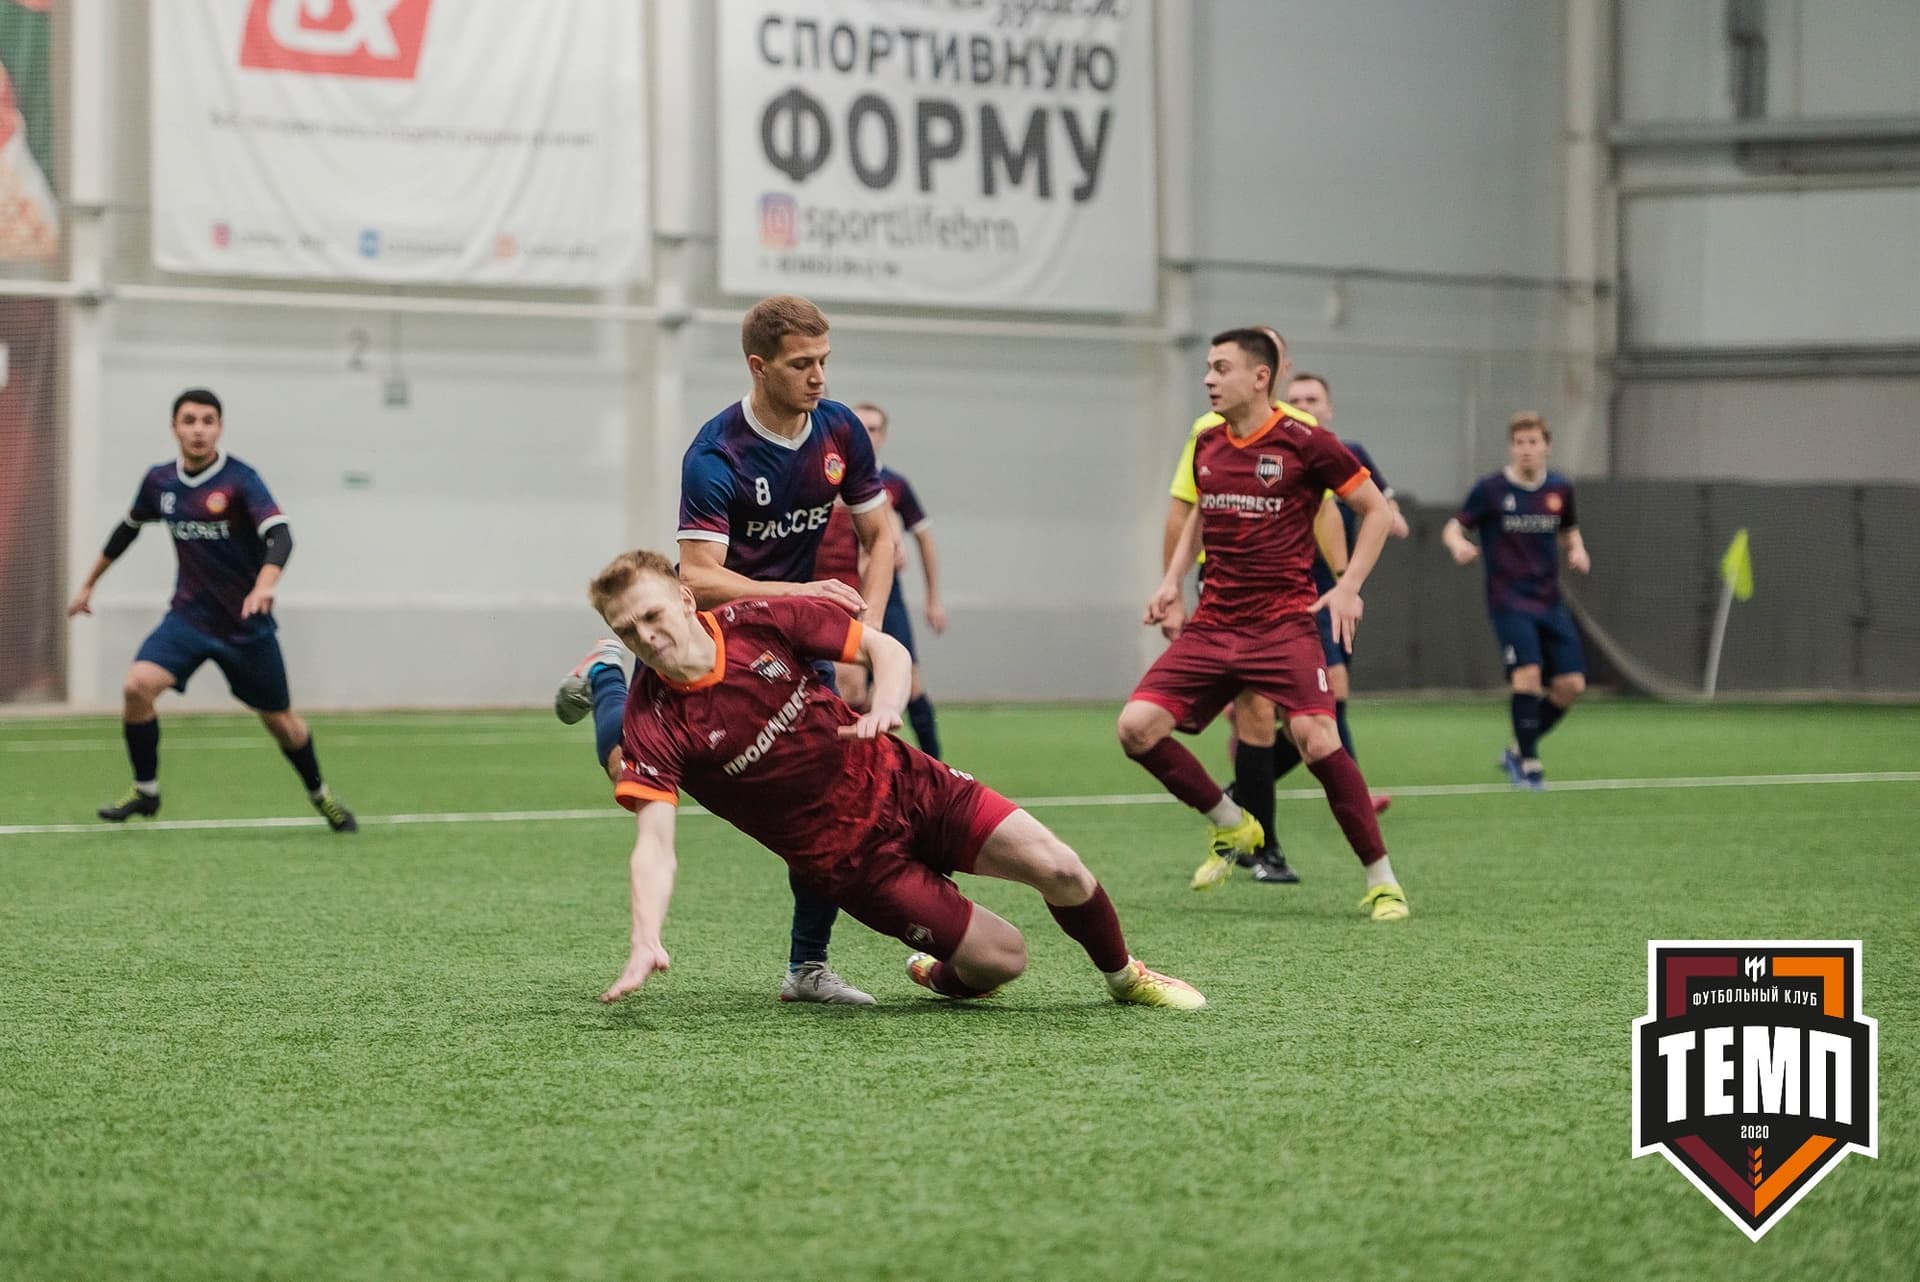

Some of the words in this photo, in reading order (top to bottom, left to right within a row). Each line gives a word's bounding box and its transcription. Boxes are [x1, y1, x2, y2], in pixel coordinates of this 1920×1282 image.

[760, 15, 1116, 92] СПОРТИВНУЮ
[761, 88, 1111, 201] ФОРМУ
[160, 491, 176, 514] 12
[755, 476, 771, 506] 8
[746, 502, 833, 540] РАССВЕ
